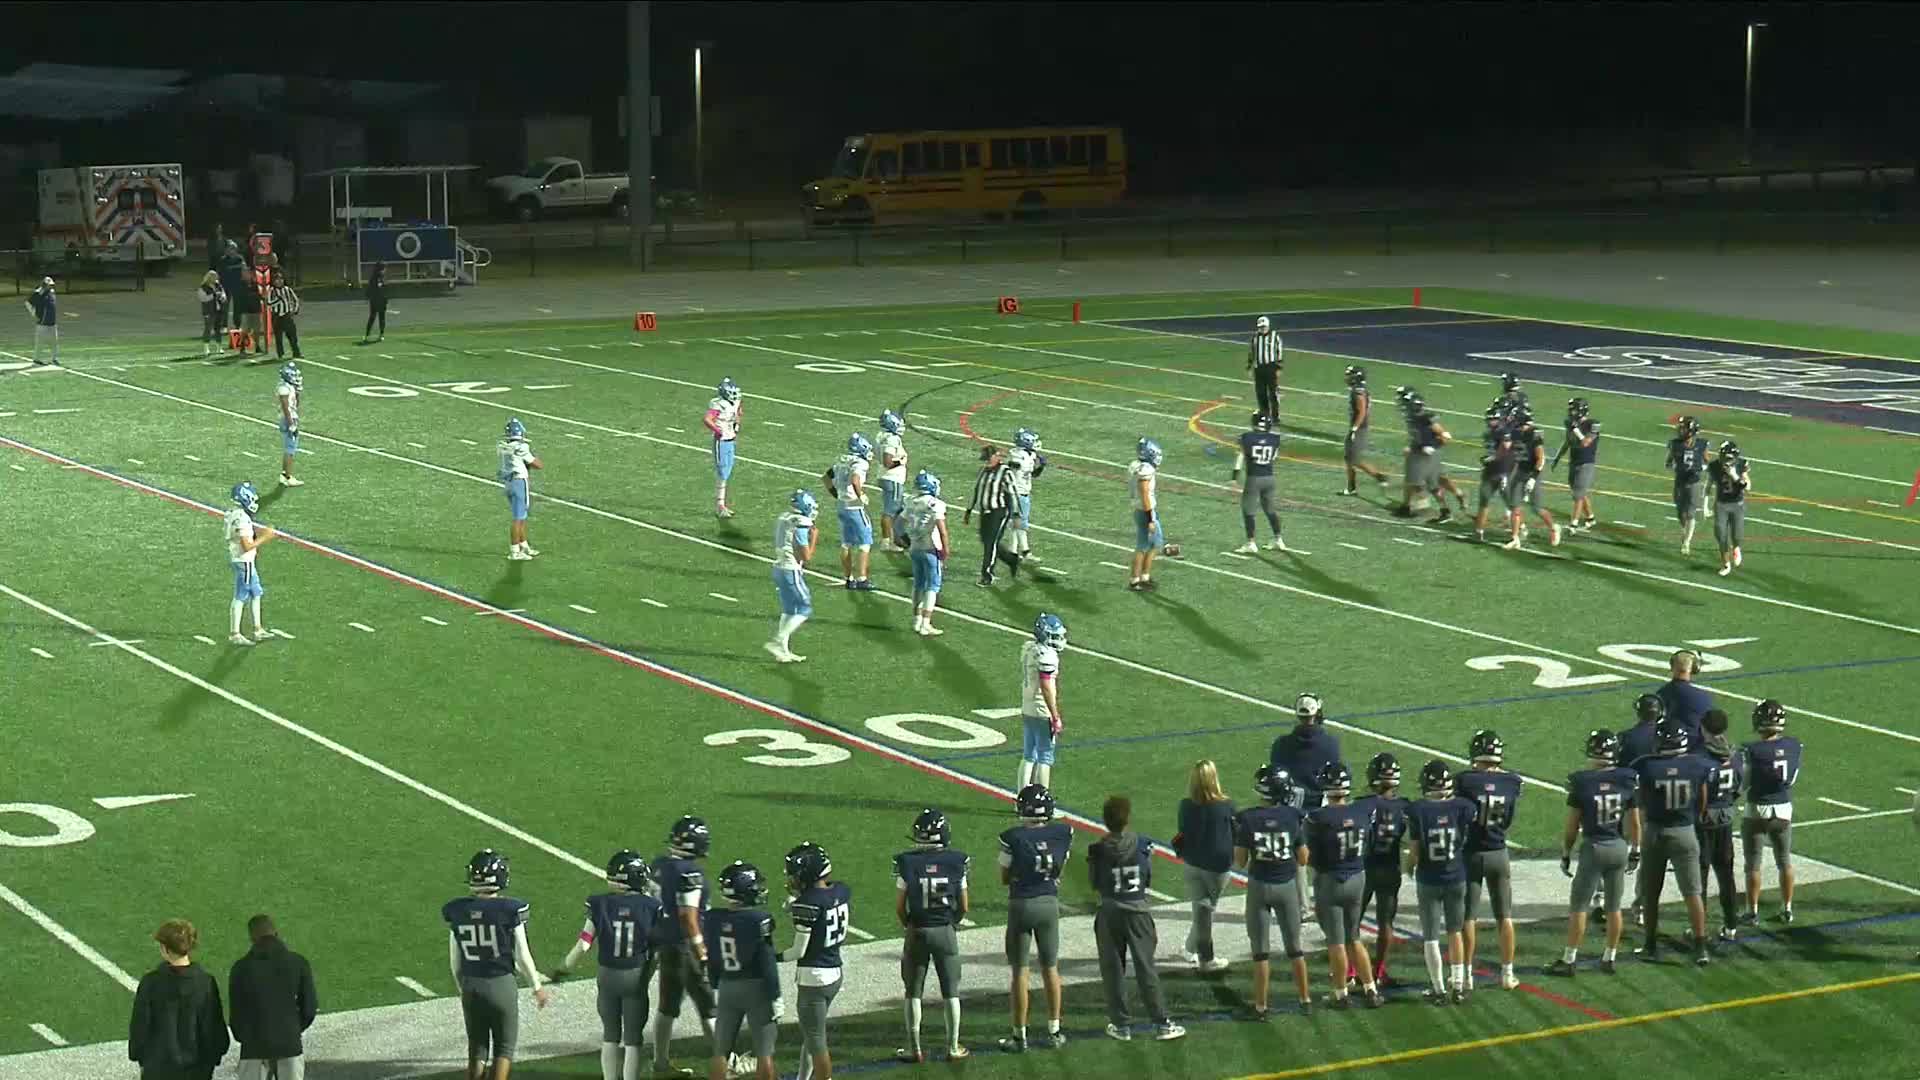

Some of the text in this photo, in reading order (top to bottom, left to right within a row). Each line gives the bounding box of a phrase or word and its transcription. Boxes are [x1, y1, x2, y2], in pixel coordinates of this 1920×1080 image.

[640, 314, 654, 329] 10
[1003, 298, 1017, 312] G
[1252, 445, 1273, 465] 50
[1464, 643, 1743, 689] 20
[702, 713, 1007, 767] 30
[1774, 759, 1788, 783] 7
[1336, 828, 1365, 860] 14
[1427, 828, 1457, 862] 21
[1035, 854, 1054, 881] 4
[458, 924, 500, 961] 24
[612, 920, 636, 958] 11
[824, 902, 849, 949] 23
[719, 935, 741, 972] 8
